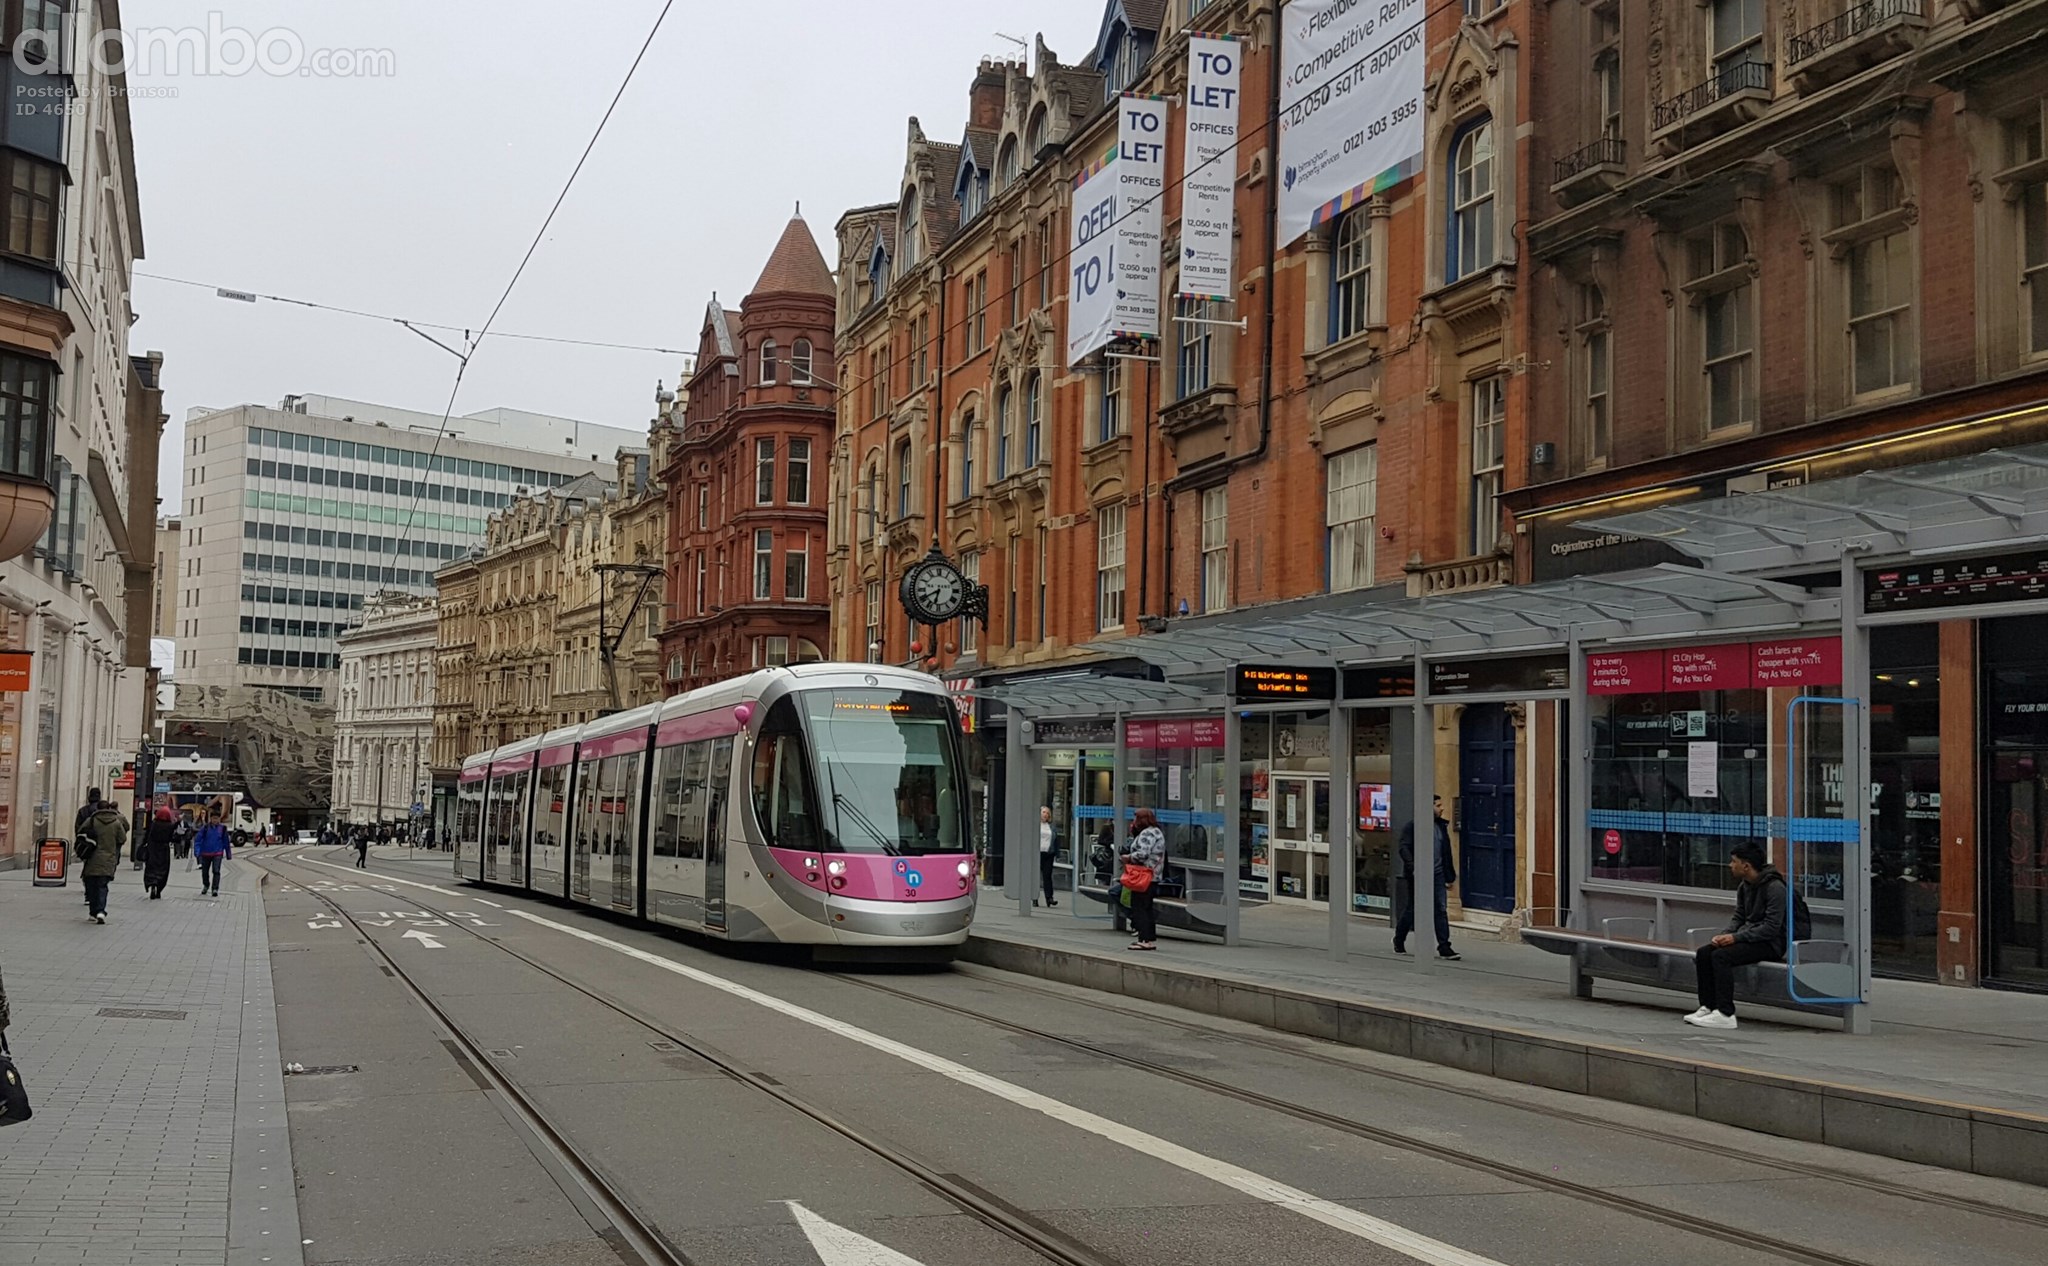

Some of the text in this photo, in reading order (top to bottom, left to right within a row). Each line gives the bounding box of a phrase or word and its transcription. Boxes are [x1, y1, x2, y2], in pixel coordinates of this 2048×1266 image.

[1294, 19, 1374, 85] Competitive
[1198, 52, 1232, 75] TO
[1290, 27, 1421, 127] 12,050 sq ft approx
[1190, 85, 1236, 109] LET
[1127, 111, 1159, 132] TO
[1343, 98, 1417, 154] 0121 303 3935
[1190, 122, 1234, 136] OFFICES
[1121, 141, 1163, 163] LET
[1120, 175, 1161, 187] OFFICES
[1187, 182, 1231, 194] Competitive
[1198, 192, 1219, 201] Rents
[1187, 219, 1211, 228] 12,050
[1119, 229, 1159, 240] Competitive
[1128, 239, 1148, 247] Rents
[1074, 256, 1101, 302] TO
[1551, 537, 1594, 555] Originators
[1595, 536, 1604, 546] of
[1606, 534, 1620, 545] the
[1758, 646, 1803, 656] Cash fares are
[1593, 659, 1601, 667] Up
[1608, 658, 1622, 667] every
[1681, 654, 1692, 662] City
[1693, 653, 1705, 662] Hop
[1758, 658, 1783, 668] cheaper
[1785, 657, 1799, 666] with
[1672, 665, 1684, 673] 90p
[1758, 671, 1769, 680] Pay
[1770, 670, 1779, 678] As
[1793, 669, 1802, 677] Go
[1593, 679, 1610, 687] during
[1620, 677, 1631, 686] day
[1672, 676, 1683, 684] Pay
[1703, 674, 1712, 682] Go
[2005, 704, 2016, 713] FLY
[2018, 703, 2036, 713] YOUR
[44, 859, 58, 871] NO
[905, 889, 917, 897] 30
